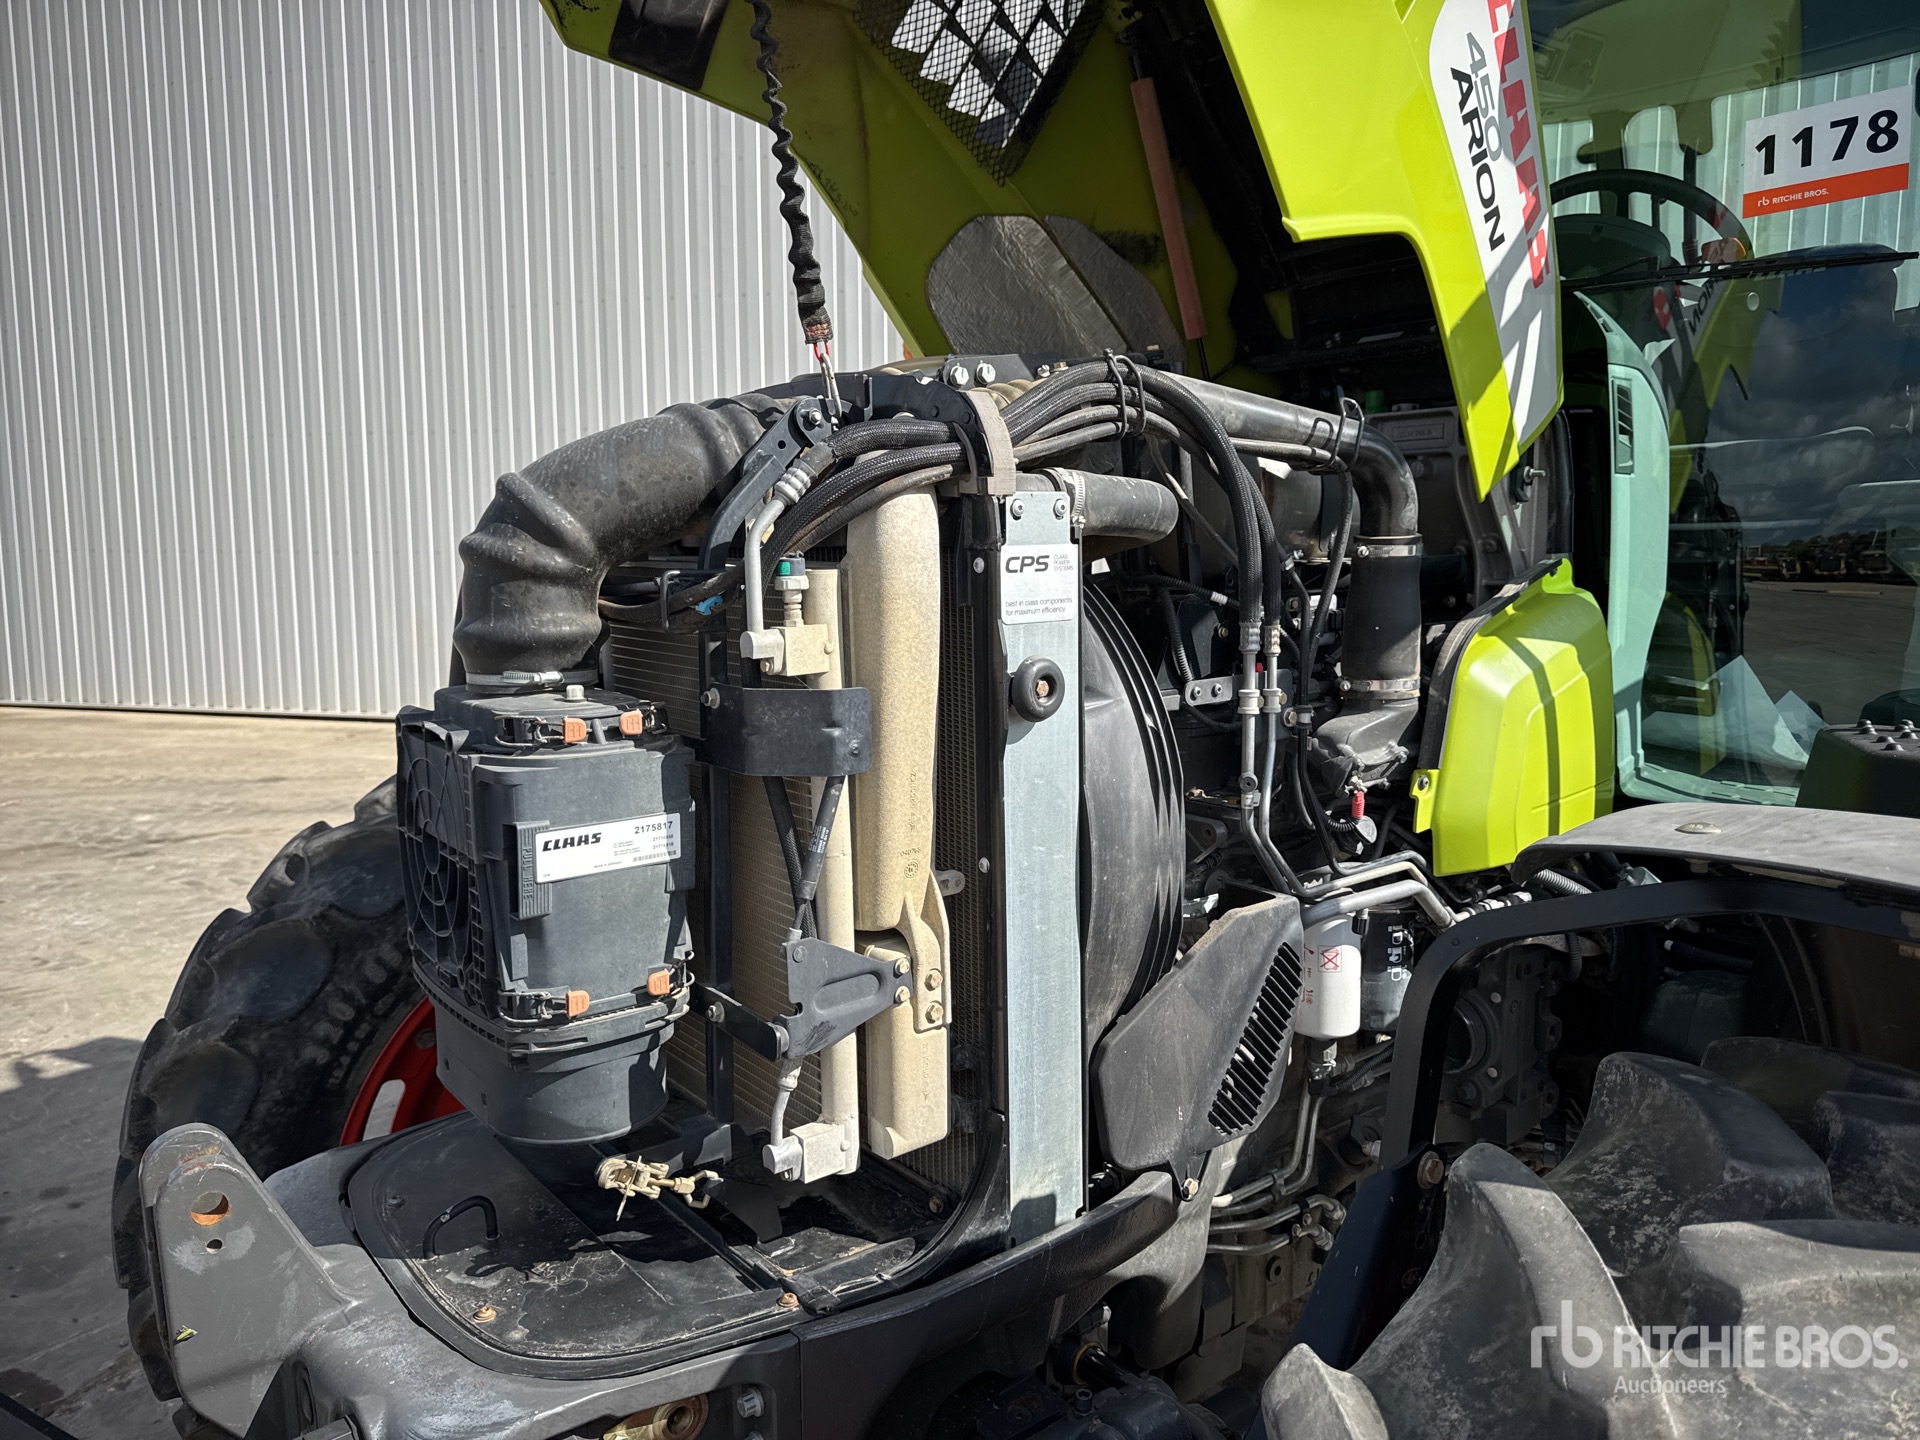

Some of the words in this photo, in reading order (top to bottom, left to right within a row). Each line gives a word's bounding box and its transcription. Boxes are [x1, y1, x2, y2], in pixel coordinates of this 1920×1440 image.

[1466, 31, 1502, 162] 450
[1755, 109, 1899, 175] 1178
[1450, 67, 1505, 251] ARION
[1757, 196, 1770, 207] rb
[1772, 192, 1803, 204] RITCHIE
[1804, 188, 1829, 199] BROS.
[1005, 555, 1050, 573] CPS
[1039, 597, 1073, 606] components
[1041, 606, 1066, 615] efficiency
[634, 821, 673, 835] 2175817
[542, 832, 602, 852] CLAAS
[522, 848, 534, 871] PULL
